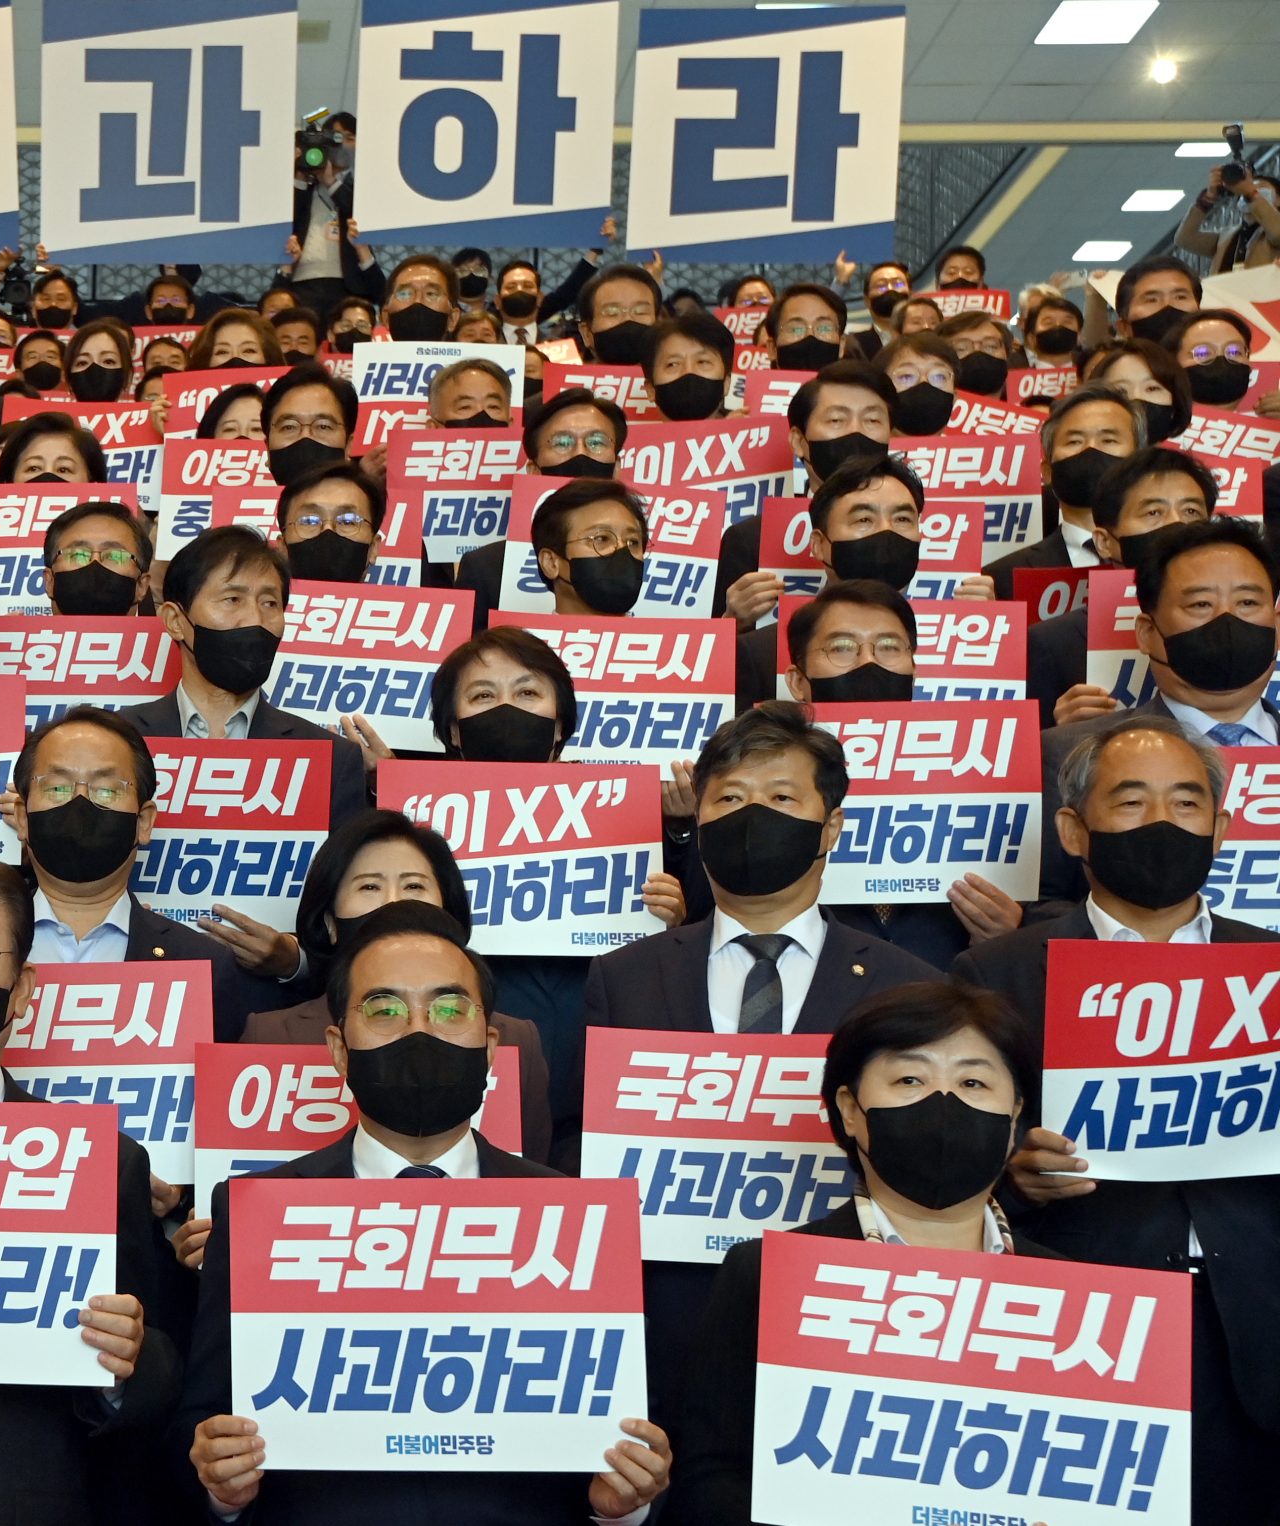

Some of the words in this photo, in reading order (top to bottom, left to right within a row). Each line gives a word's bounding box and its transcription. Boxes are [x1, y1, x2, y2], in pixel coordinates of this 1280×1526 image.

[404, 439, 528, 482] 국회무
[681, 426, 770, 481] XX”
[498, 778, 627, 846] XX”
[865, 878, 940, 893] 더불어민주당
[1079, 978, 1204, 1058] “이
[616, 1051, 829, 1126] 국회무
[269, 1202, 608, 1294] 국회무시
[798, 1263, 1157, 1383] 국회무시
[250, 1326, 625, 1417] 사과하라!
[385, 1434, 496, 1455] 더불어민주당
[773, 1385, 1170, 1513] 사과하라!
